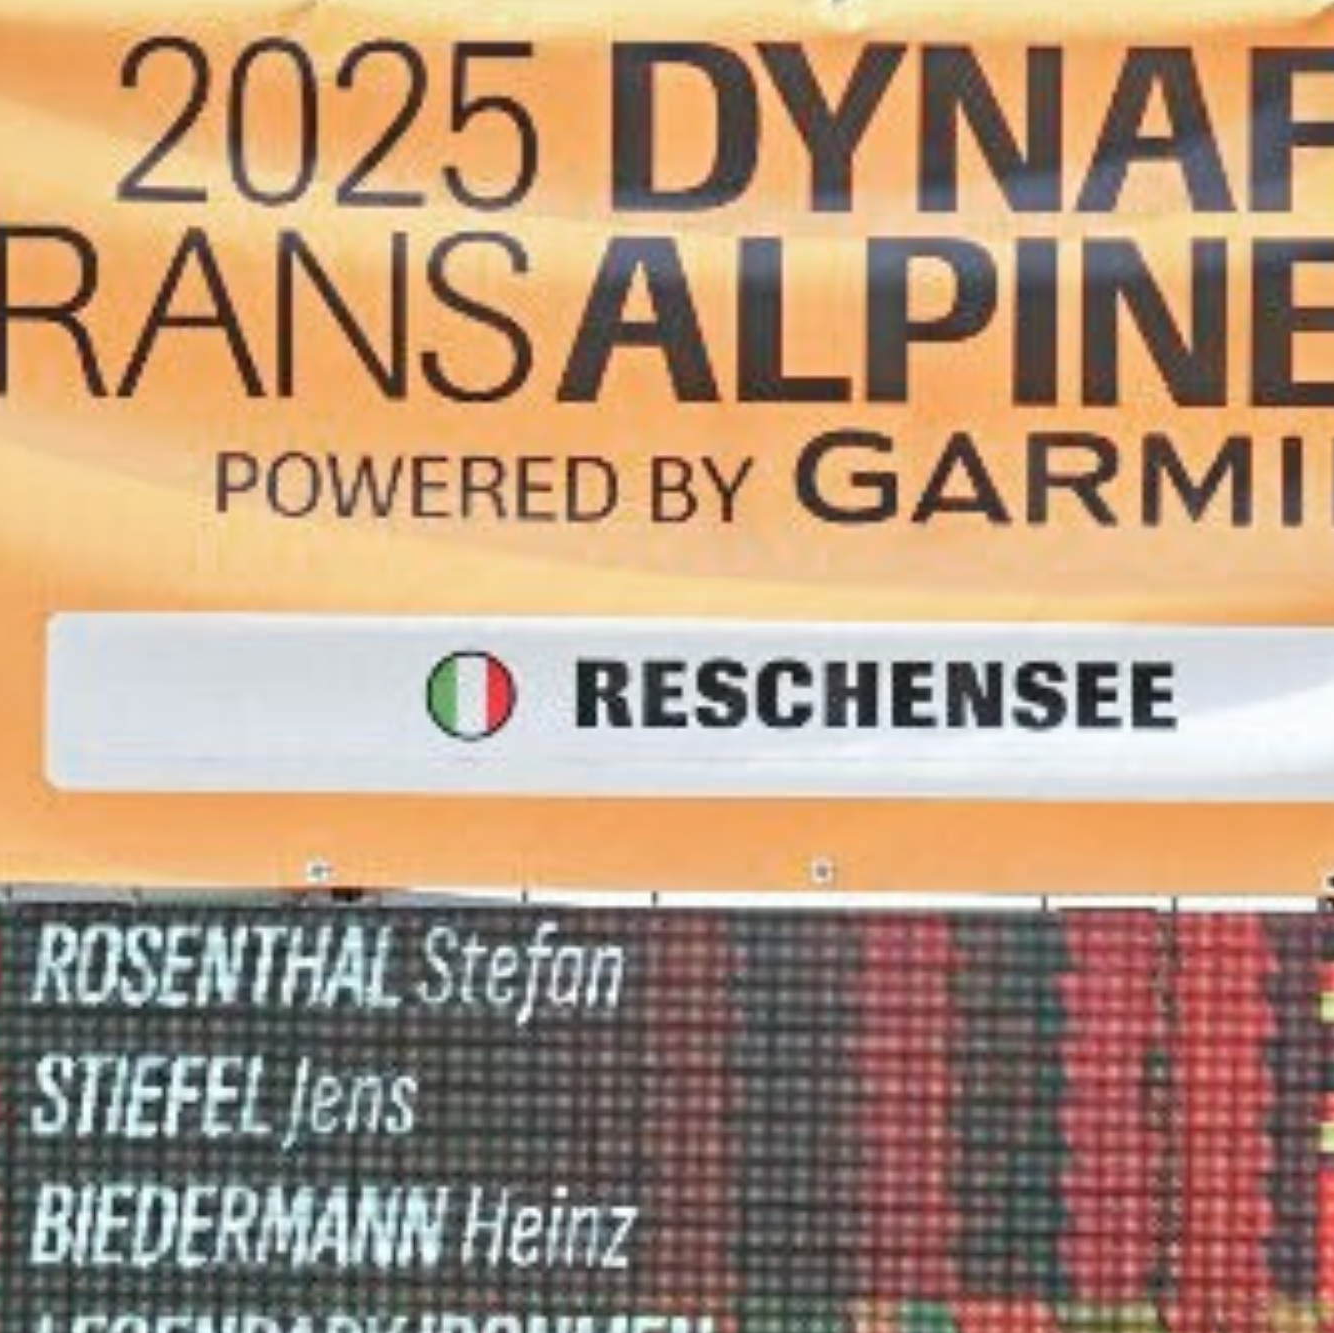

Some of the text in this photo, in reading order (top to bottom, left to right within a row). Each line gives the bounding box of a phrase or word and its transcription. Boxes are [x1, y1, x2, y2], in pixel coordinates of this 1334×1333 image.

[117, 35, 539, 211] 2025
[216, 452, 619, 524] POWERED
[650, 455, 755, 525] BY
[575, 658, 1179, 731] RESCHENSEE
[31, 922, 625, 1026] ROSENTHAL Stefan
[31, 1055, 269, 1136] STIEFEL
[281, 1058, 419, 1153] Jens
[31, 1184, 450, 1268] BIEDERMANN
[461, 1188, 639, 1269] Heinz
